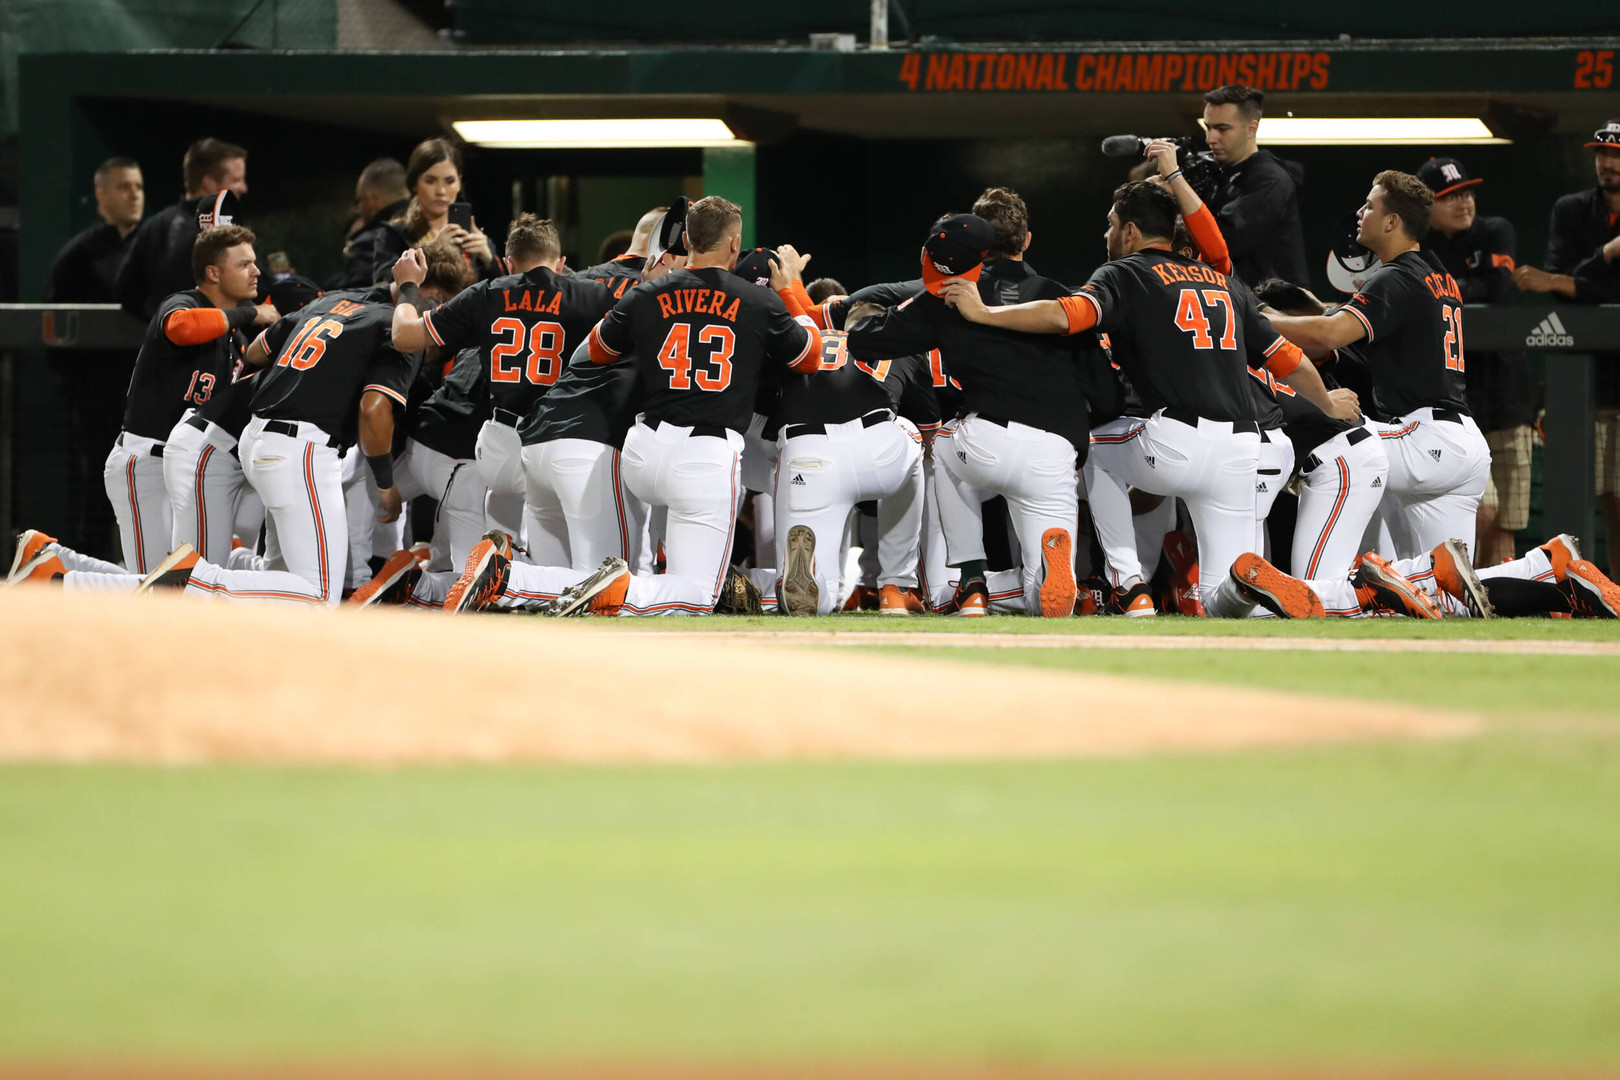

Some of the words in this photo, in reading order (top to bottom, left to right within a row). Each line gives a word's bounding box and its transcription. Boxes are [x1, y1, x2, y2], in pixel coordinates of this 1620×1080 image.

[899, 53, 921, 90] 4
[925, 53, 1069, 90] NATIONAL
[1075, 52, 1331, 91] CHAMPIONSHIPS
[1574, 50, 1615, 88] 25
[1151, 262, 1229, 291] KEYSOR
[502, 289, 563, 316] LALA
[656, 288, 741, 322] RIVERA
[1174, 288, 1237, 350] 47
[277, 316, 344, 371] 16
[490, 317, 566, 387] 28
[657, 323, 736, 392] 43
[1442, 304, 1465, 373] 21
[1525, 333, 1575, 347] adidas
[183, 369, 216, 405] 13
